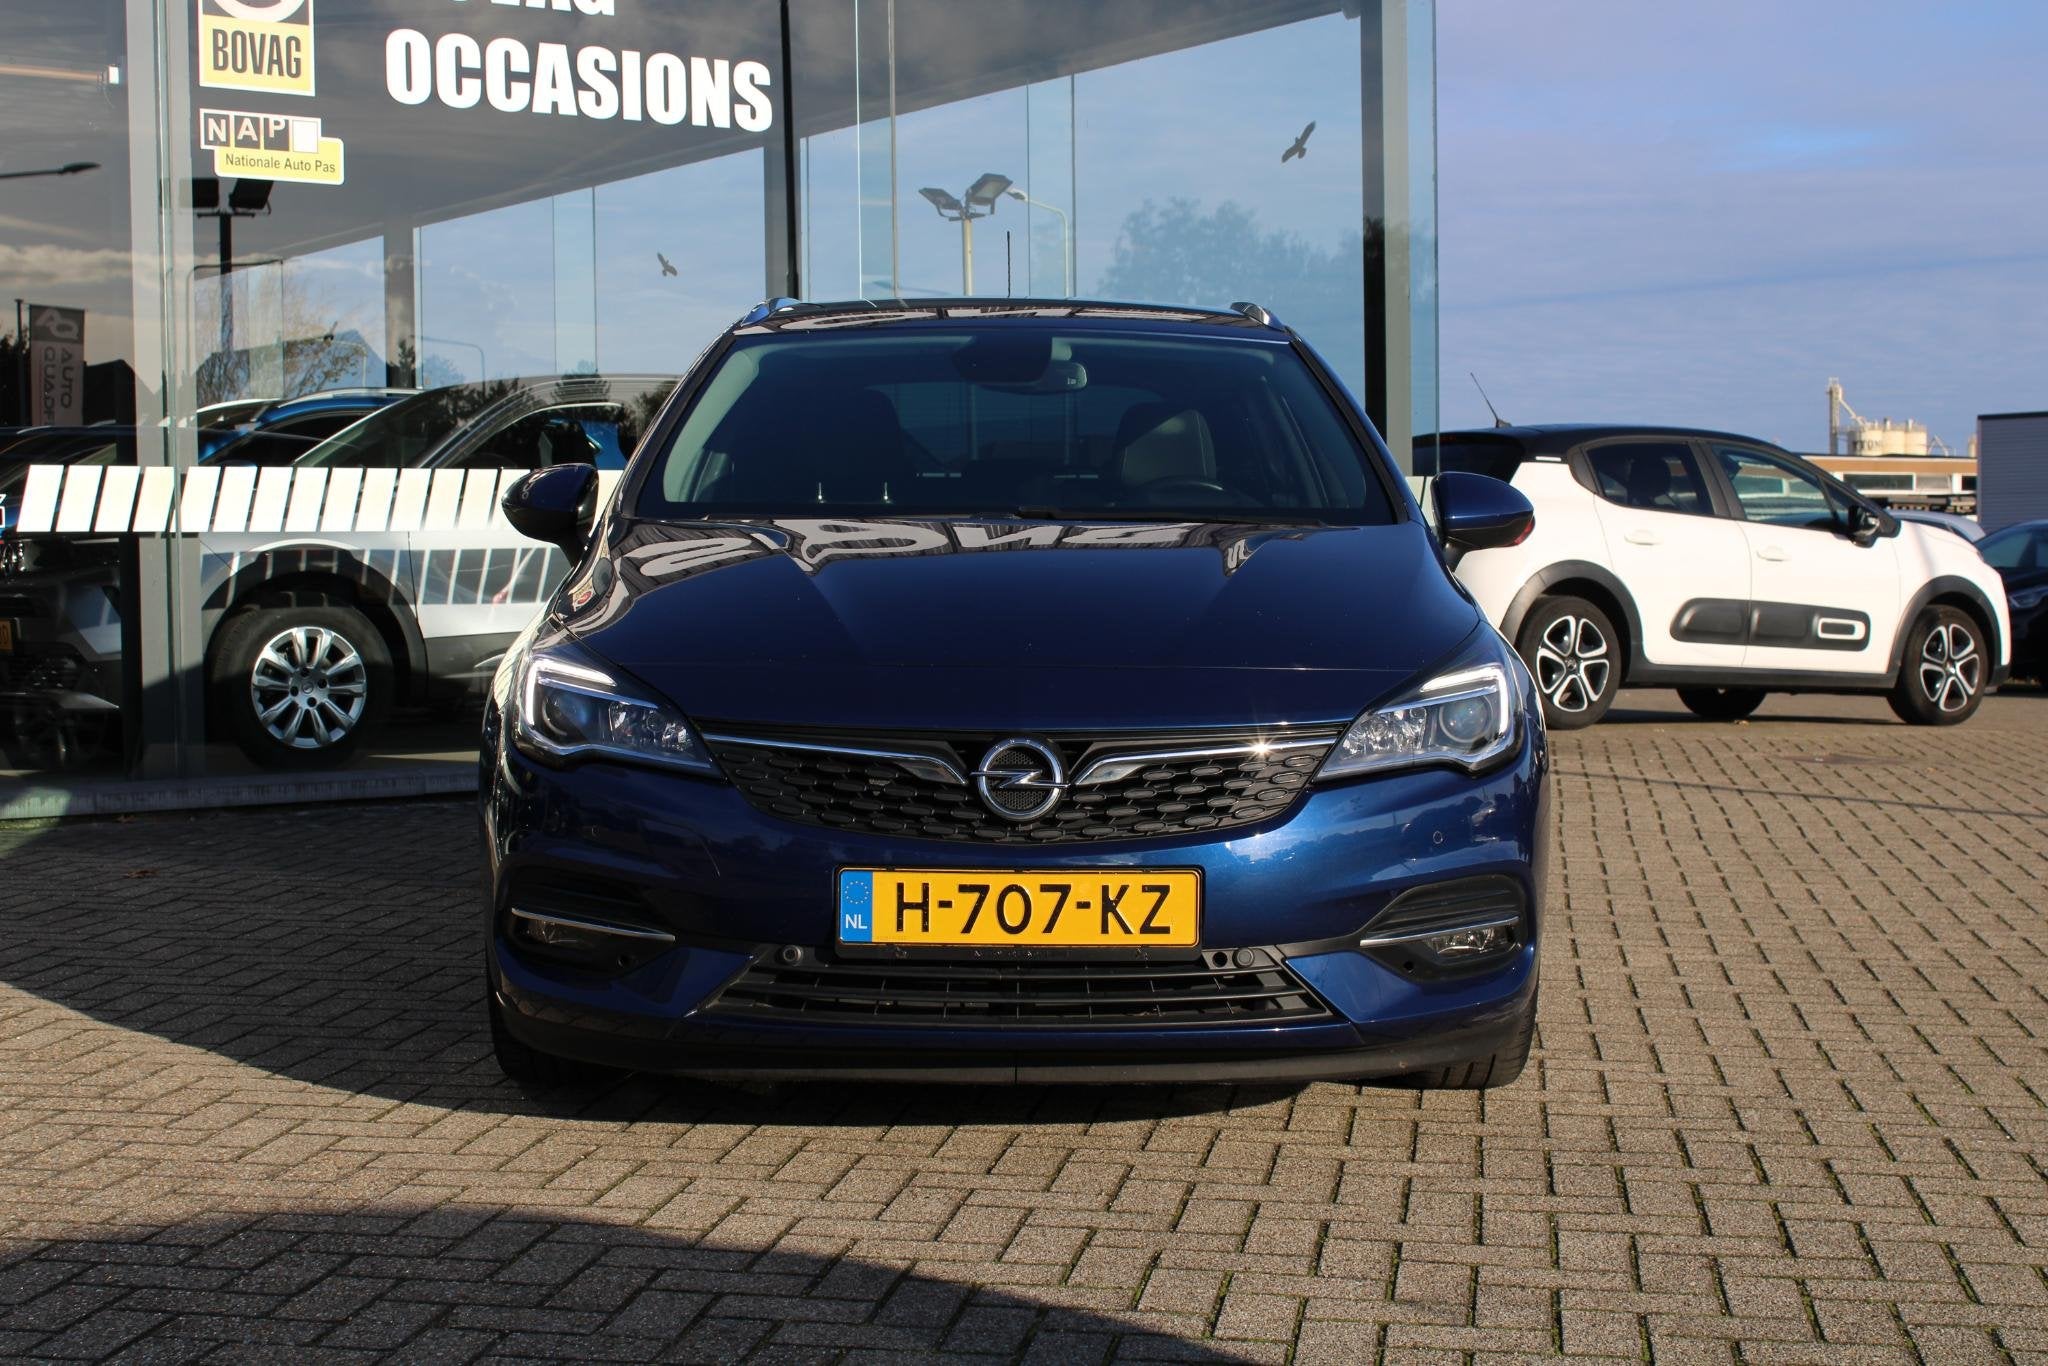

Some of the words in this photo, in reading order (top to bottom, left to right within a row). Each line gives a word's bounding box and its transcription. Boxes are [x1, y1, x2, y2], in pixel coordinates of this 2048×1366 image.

[212, 28, 302, 78] BOVAG
[385, 28, 773, 132] OCCASIONS
[207, 115, 287, 142] NAP
[225, 153, 281, 169] Nationale
[284, 158, 312, 172] Auto
[315, 160, 336, 173] Pas
[845, 914, 868, 930] NL
[896, 882, 1171, 935] H-707-KZ
